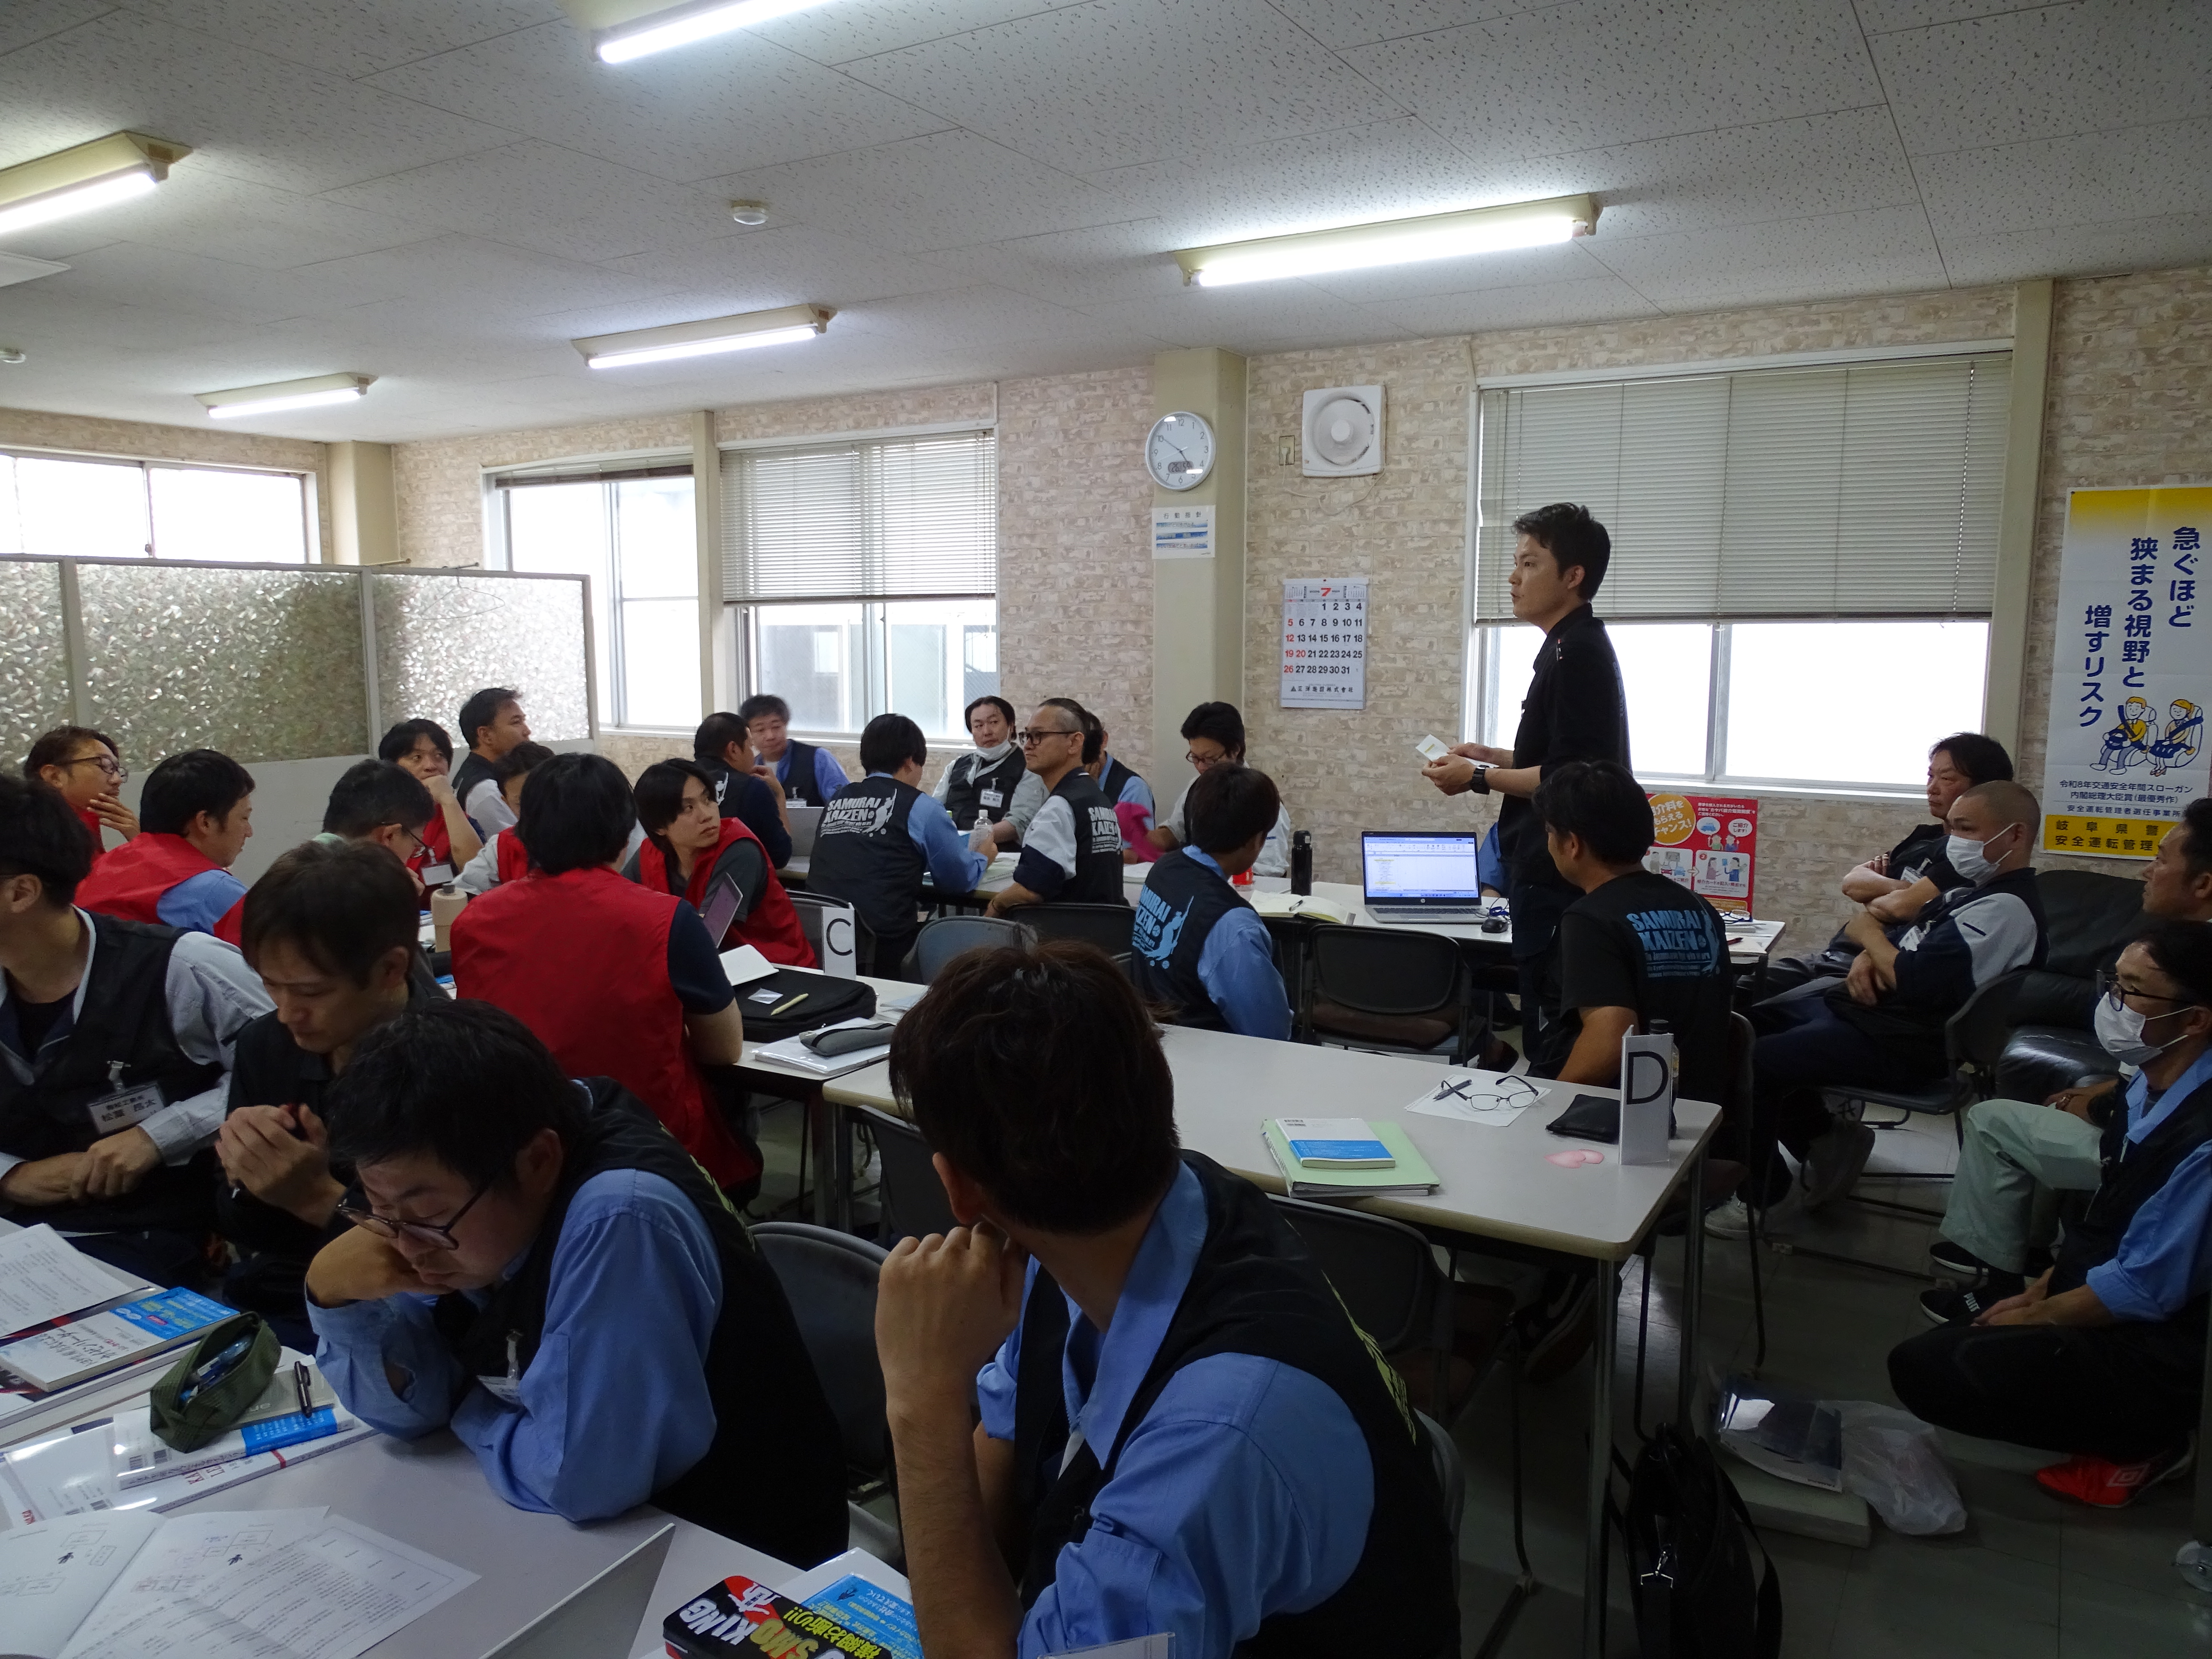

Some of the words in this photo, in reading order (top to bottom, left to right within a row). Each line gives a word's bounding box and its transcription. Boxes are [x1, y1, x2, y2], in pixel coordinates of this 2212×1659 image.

[2168, 526, 2200, 627] 急ぐほど
[1321, 588, 1331, 597] 7
[2122, 537, 2158, 687] 狭まる視野と
[1285, 650, 1294, 658] 19
[1296, 650, 1306, 658] 20
[1308, 650, 1316, 658] 21
[1319, 650, 1328, 658] 22
[1330, 650, 1339, 658] 23
[1342, 650, 1351, 658] 24
[1353, 650, 1362, 658] 25
[1284, 666, 1293, 674] 26
[1296, 666, 1305, 674] 27
[1307, 666, 1317, 674] 28
[1318, 666, 1328, 674] 29
[1329, 666, 1339, 674] 30
[1341, 666, 1350, 674] 31
[2079, 604, 2112, 727] 増すリスク
[2060, 780, 2193, 793] 令和8年交通安全年間スローガン
[828, 797, 882, 811] SAMURAI
[824, 809, 869, 824] KAIZEN
[2055, 835, 2160, 851] 安全運転管理
[1627, 910, 1702, 931] SAMURAI
[827, 918, 853, 956] C
[1637, 930, 1699, 951] KAIZEN
[1626, 1051, 1668, 1105] D
[783, 1606, 882, 1659] 横綱お断り!!
